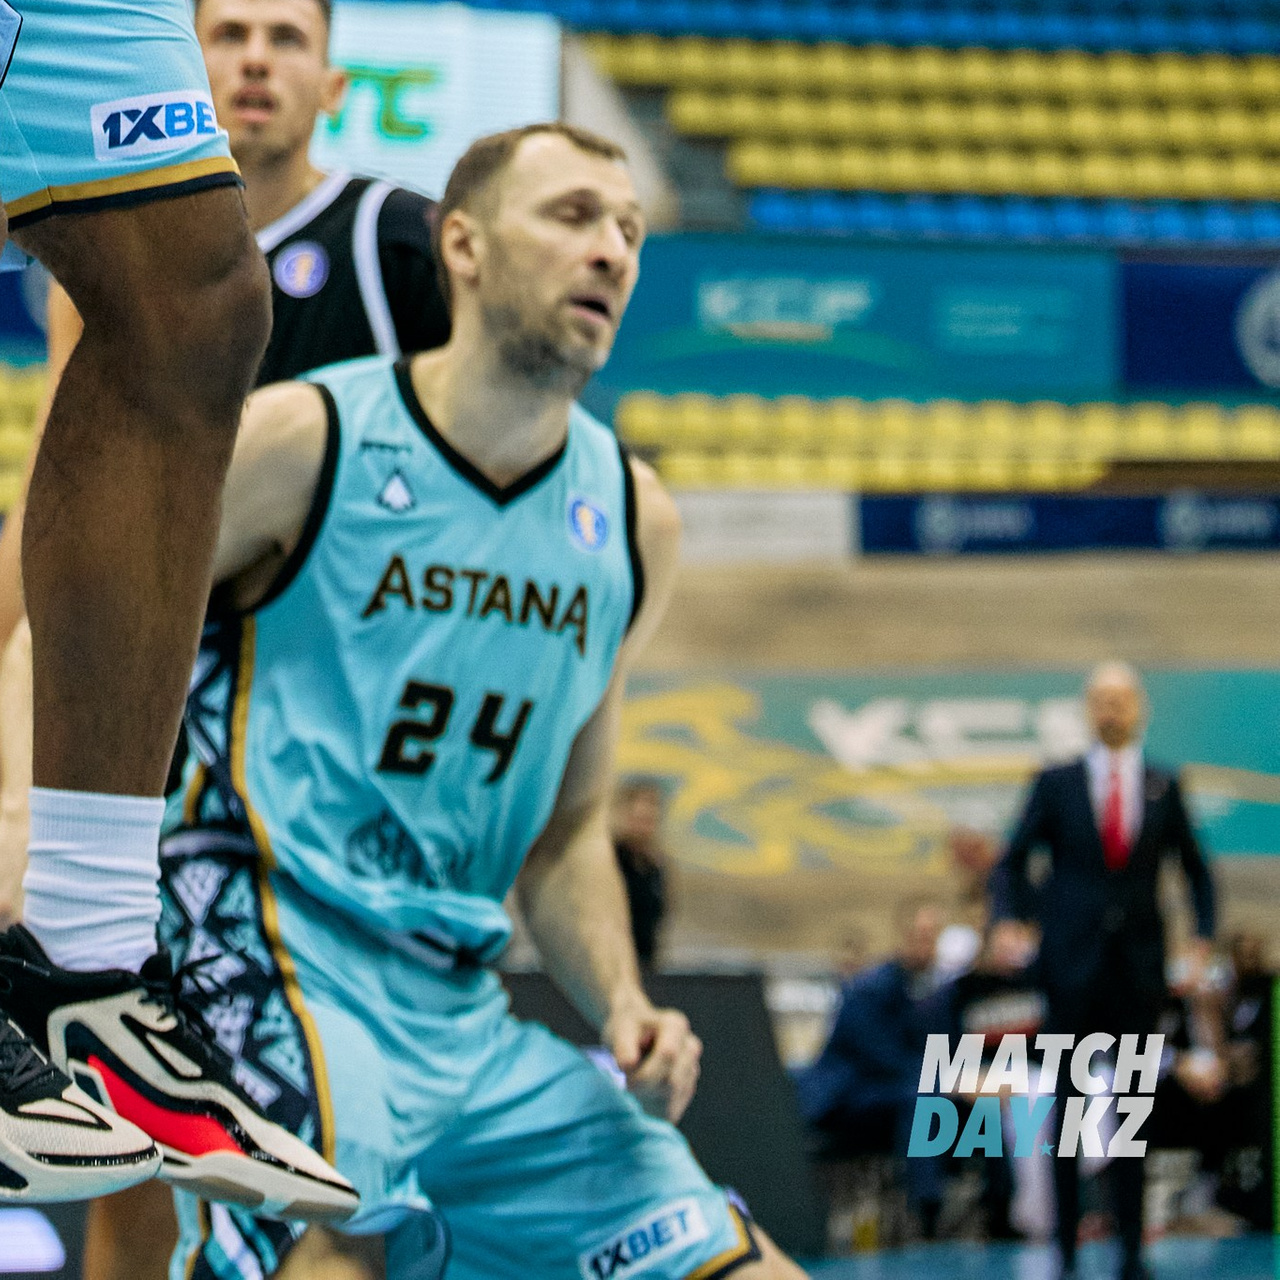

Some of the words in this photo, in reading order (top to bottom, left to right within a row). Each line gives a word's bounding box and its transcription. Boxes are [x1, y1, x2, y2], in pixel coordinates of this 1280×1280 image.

[103, 101, 217, 149] 1XBE
[361, 554, 588, 658] ASTANA
[375, 679, 534, 785] 24
